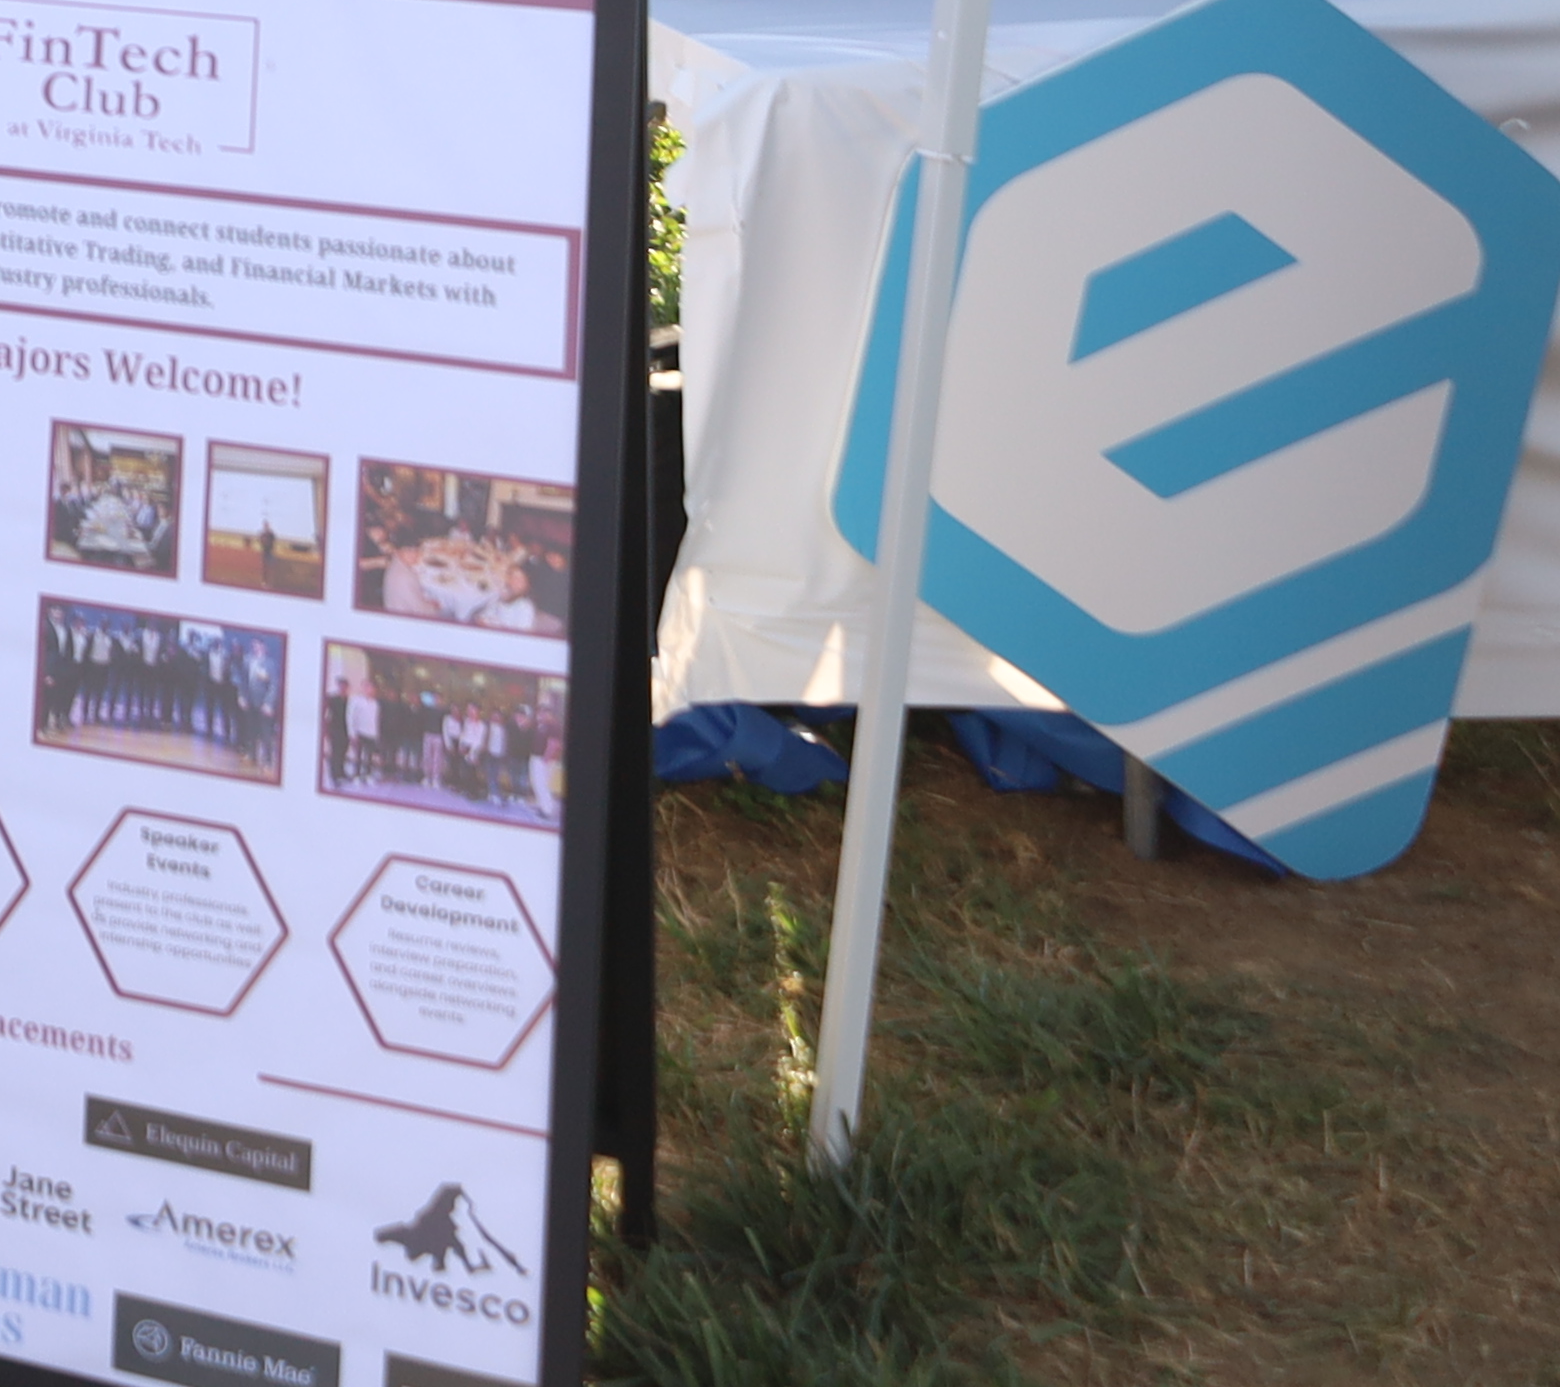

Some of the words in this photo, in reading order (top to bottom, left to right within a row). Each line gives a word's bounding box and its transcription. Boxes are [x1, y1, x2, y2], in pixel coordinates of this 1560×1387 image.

[41, 71, 160, 117] Club
[103, 349, 300, 406] Welcome!
[2, 1165, 72, 1203] Jane
[0, 1188, 91, 1234] Street
[153, 1199, 294, 1260] Amerex
[370, 1260, 533, 1327] Invesco
[180, 1335, 257, 1373] Fannie
[263, 1355, 317, 1387] Mae
